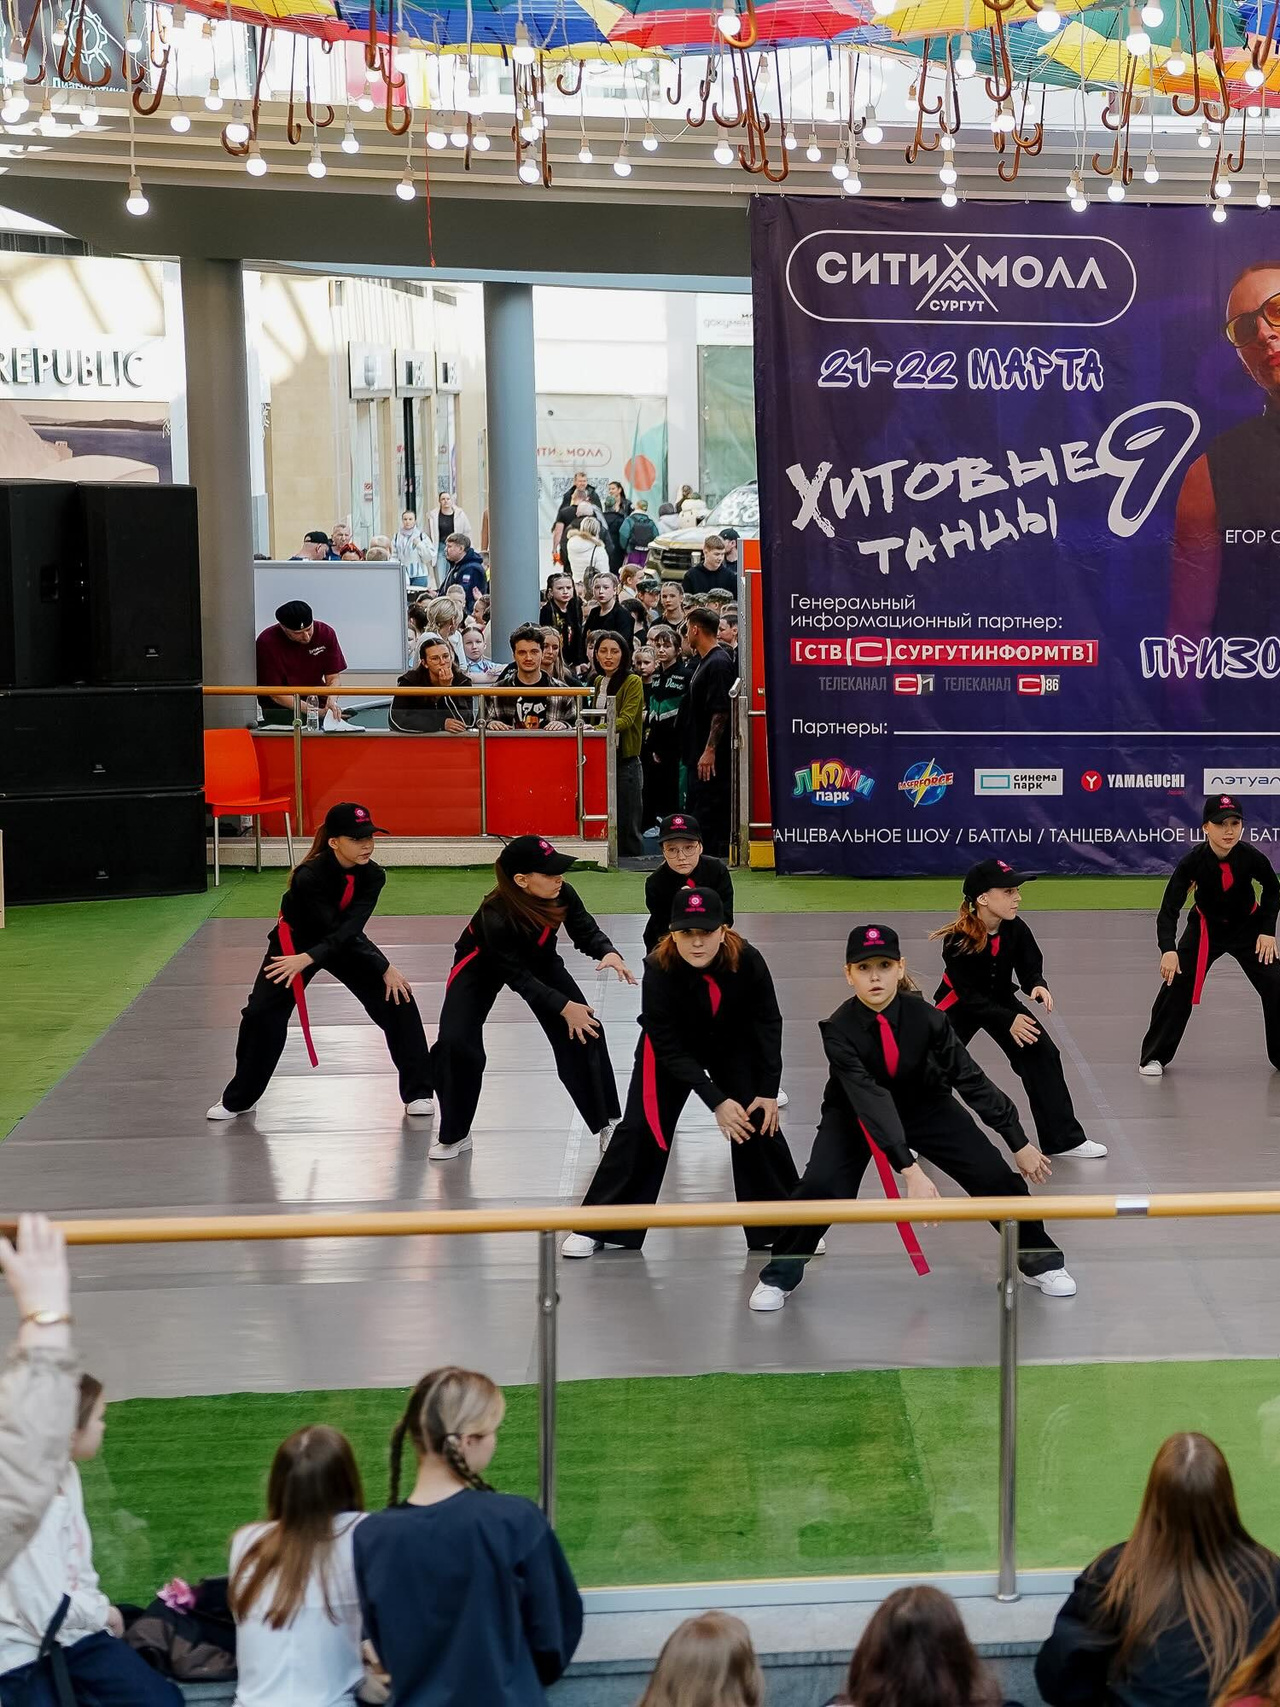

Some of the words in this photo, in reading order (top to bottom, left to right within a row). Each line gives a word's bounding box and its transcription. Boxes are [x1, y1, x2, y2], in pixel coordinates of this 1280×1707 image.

[930, 300, 985, 312] СУРГУТ
[0, 348, 144, 388] REPUBLIC
[818, 347, 957, 389] 21-22
[967, 348, 1104, 392] МАРТА
[1225, 530, 1266, 544] ЕГОР
[790, 594, 916, 611] Генеральный
[790, 612, 972, 631] информационный
[978, 615, 1063, 630] партнер:
[818, 676, 887, 692] ТЕЛЕКАНАЛ
[943, 677, 1011, 692] ТЕЛЕКАНАЛ
[791, 719, 888, 736] Партнеры:
[1013, 774, 1057, 782] синема
[1107, 774, 1185, 788] YAMAGUCHI
[1013, 782, 1043, 792] парк
[816, 791, 850, 803] парк
[907, 828, 950, 843] ШОУ
[968, 828, 1032, 843] БАТТЛЫ
[1049, 828, 1185, 844] ТАНЦЕВАЛЬНОЕ
